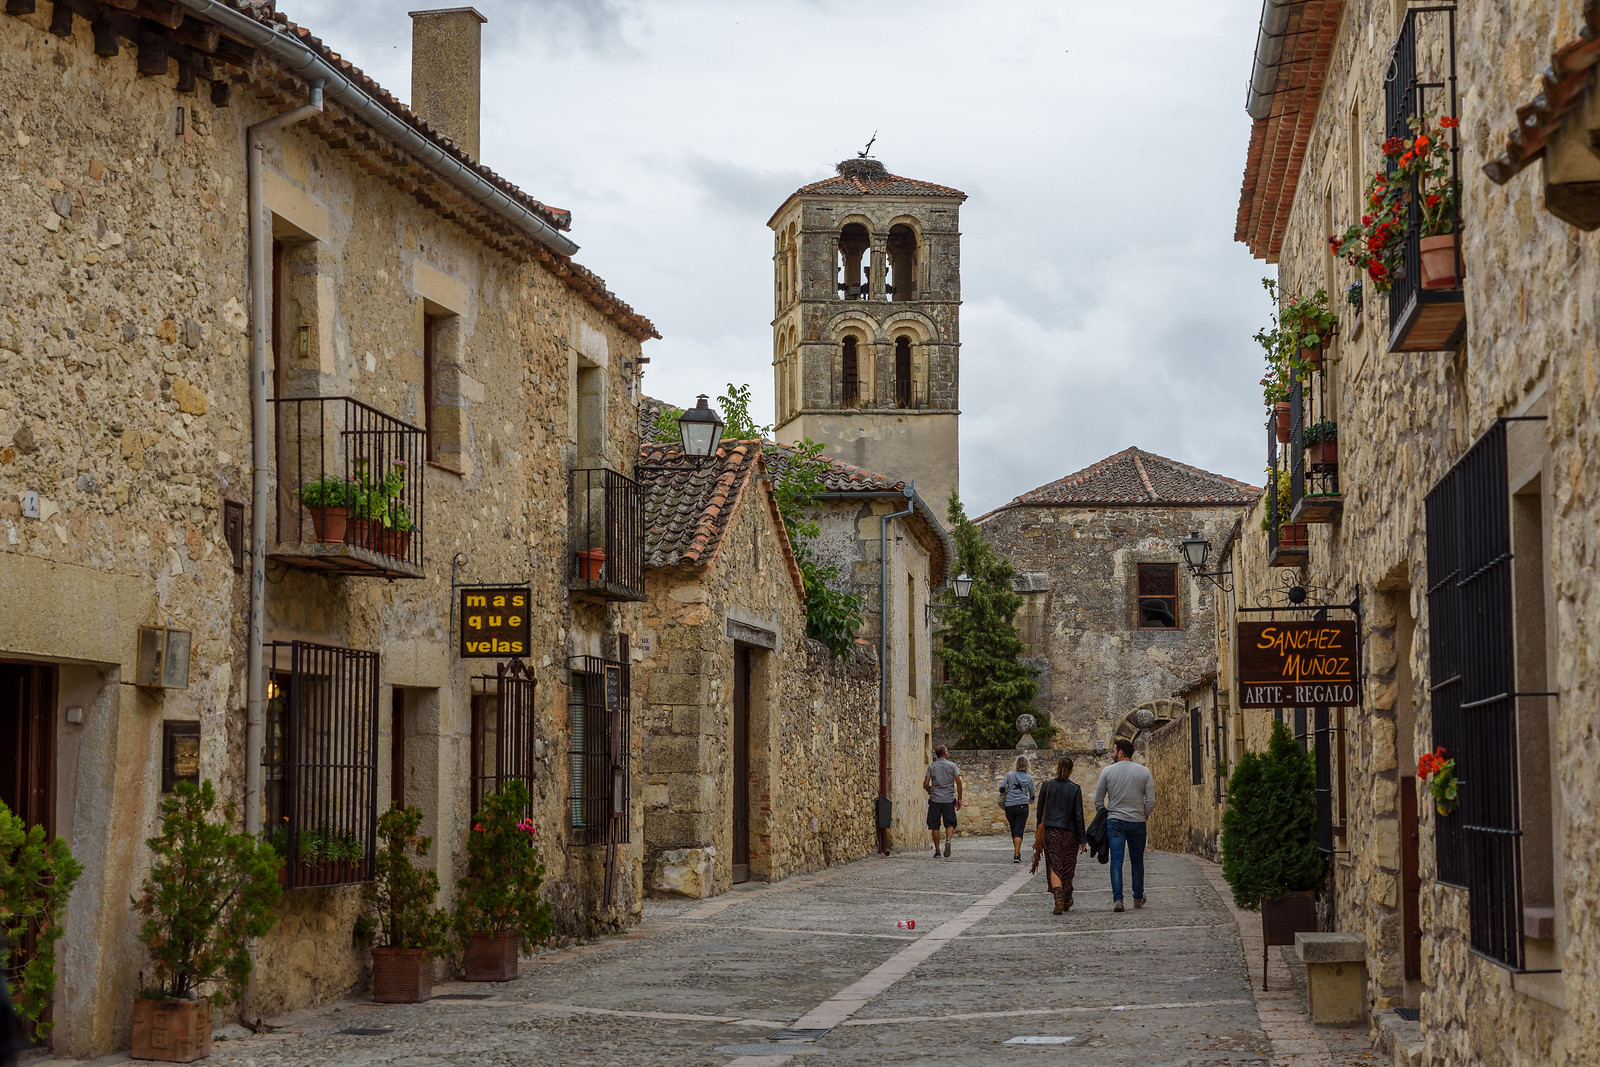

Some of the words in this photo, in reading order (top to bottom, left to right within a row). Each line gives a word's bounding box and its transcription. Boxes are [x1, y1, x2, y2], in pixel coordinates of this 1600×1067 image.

[466, 595, 524, 607] mas
[468, 615, 522, 630] que
[466, 638, 523, 653] velas
[1257, 627, 1342, 657] SANCHEZ
[1282, 654, 1350, 683] MUÑOZ
[1245, 686, 1283, 704] ARTE
[1295, 684, 1354, 703] REGALO
